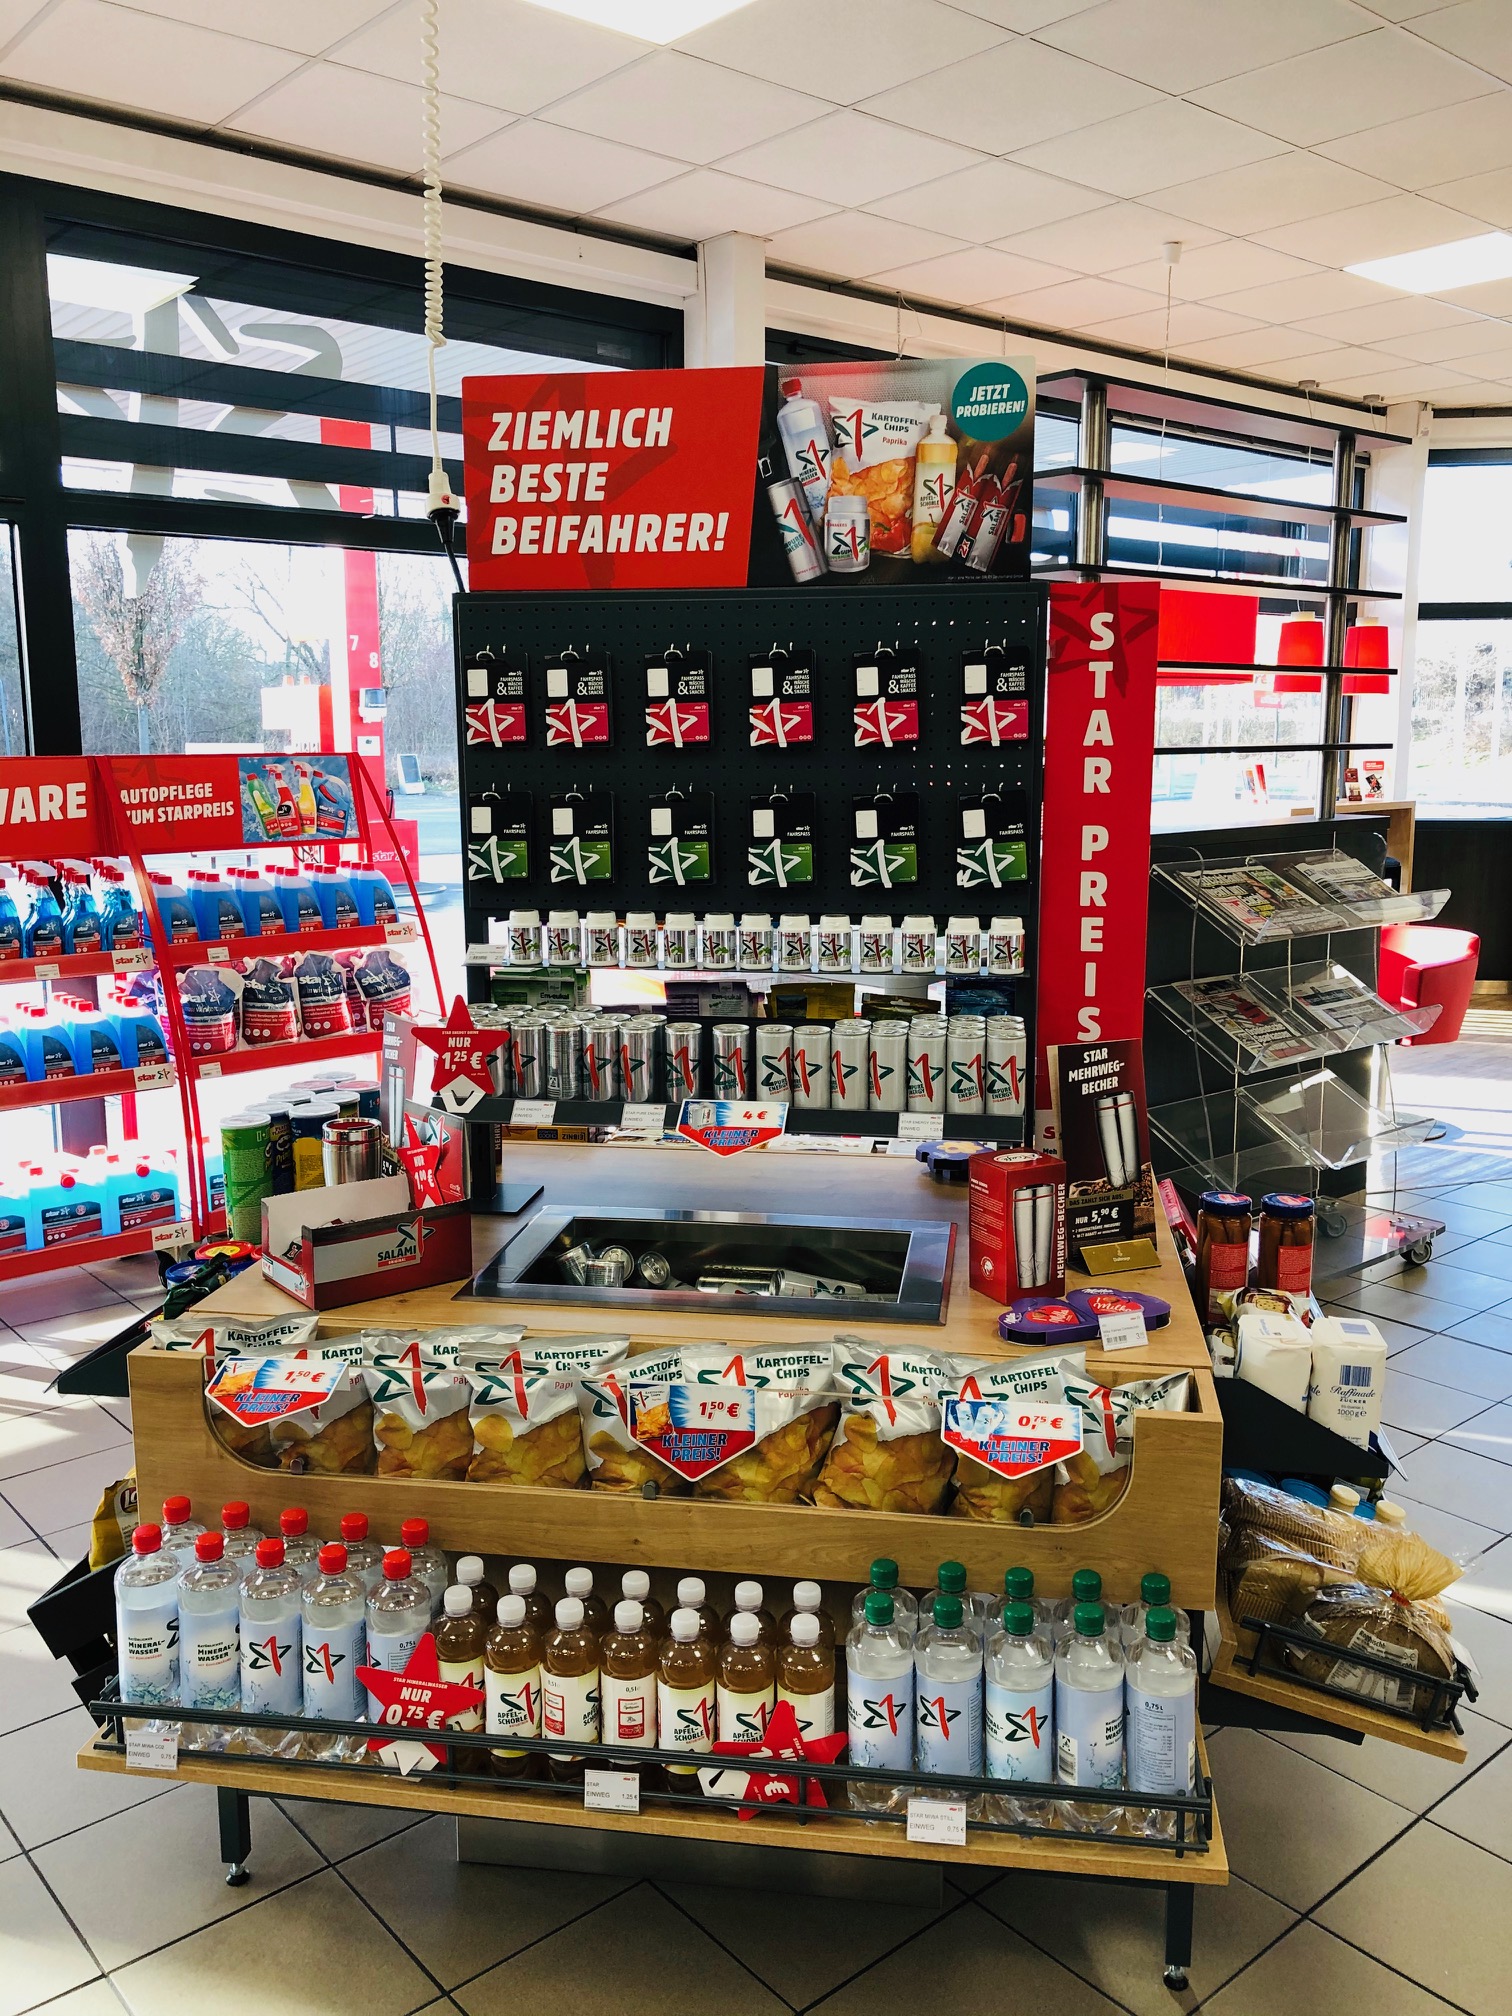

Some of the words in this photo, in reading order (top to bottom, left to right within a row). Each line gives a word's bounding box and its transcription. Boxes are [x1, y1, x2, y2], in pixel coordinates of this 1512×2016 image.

[970, 384, 1010, 402] JETZT
[956, 400, 1025, 418] PROBIEREN!
[871, 413, 923, 427] KARTOFFEL-
[487, 406, 673, 452] ZIEMLICH
[882, 437, 907, 446] Paprika
[490, 462, 609, 503] BESTE
[490, 512, 730, 555] BEIFAHRER!
[350, 634, 359, 651] 7
[369, 652, 379, 669] 8
[497, 682, 507, 695] &
[577, 682, 588, 695] &
[678, 681, 689, 695] &
[782, 681, 793, 694] &
[888, 680, 900, 694] &
[997, 678, 1008, 692] &
[1083, 611, 1115, 795] STAR
[120, 783, 213, 805] AUTOPFLEGE
[157, 802, 235, 824] STARPREIS
[373, 850, 394, 861] star
[1076, 824, 1110, 1042] PREIS
[115, 957, 134, 965] star
[448, 1037, 471, 1048] NUR
[442, 1051, 467, 1072] 1,25
[470, 1051, 483, 1069] €
[1083, 1048, 1108, 1064] STAR
[137, 1074, 156, 1082] star
[1068, 1062, 1125, 1083] MEHRWEG-
[1082, 1076, 1119, 1096] BECHER
[743, 1111, 752, 1120] 4
[757, 1110, 768, 1120] €
[704, 1129, 759, 1139] KLEINER
[709, 1138, 752, 1147] PREIS!
[1075, 1216, 1088, 1225] NUR
[1091, 1208, 1110, 1224] 5,90
[1111, 1207, 1119, 1219] €
[155, 1233, 173, 1242] star
[1057, 1183, 1066, 1279] MEHRWEG-BECHER
[378, 1245, 416, 1262] SALAMI
[227, 1325, 300, 1342] KARTOFFEL-
[535, 1349, 609, 1361] KARTOFFEL-
[756, 1355, 829, 1369] KARTOFFEL-
[284, 1371, 311, 1384] 1,50
[311, 1371, 326, 1383] €
[652, 1370, 683, 1382] CHIPS
[776, 1368, 810, 1379] CHIPS
[1014, 1381, 1048, 1395] CHIPS
[1330, 1386, 1376, 1398] Raffinade
[234, 1393, 301, 1403] KLEINER
[237, 1403, 288, 1414] PREIS!
[699, 1401, 725, 1420] 1,50
[726, 1402, 741, 1419] €
[1018, 1415, 1047, 1430] 0,75
[1050, 1417, 1064, 1429] €
[662, 1433, 728, 1448] KLEINER
[979, 1440, 1051, 1452] KLEINER
[671, 1447, 722, 1463] PREIS!
[987, 1452, 1044, 1464] PREIS!
[128, 1640, 165, 1649] MINERAL-
[128, 1647, 159, 1655] WASSER
[197, 1643, 234, 1656] MINERAL-
[198, 1652, 229, 1662] WASSER
[406, 1679, 448, 1689] MINERALWASSER
[400, 1687, 432, 1703] NUR
[426, 1710, 445, 1730] €
[498, 1714, 528, 1725] SCHORLE
[674, 1727, 699, 1735] APFEL-
[674, 1730, 705, 1742] SCHORLE
[732, 1731, 758, 1739] APFEL-
[764, 1781, 791, 1797] €
[909, 1823, 935, 1831] EINWEG
